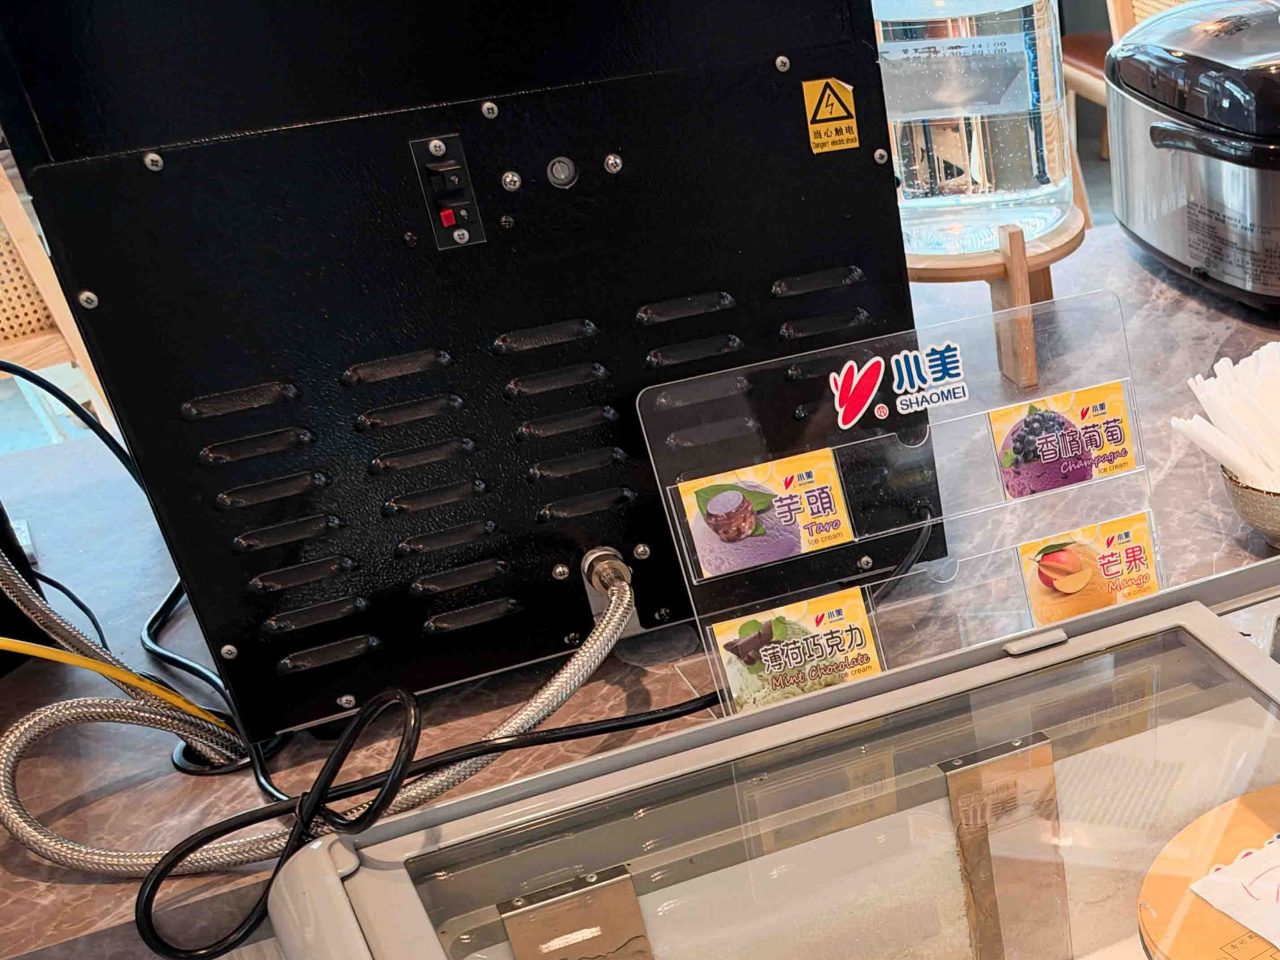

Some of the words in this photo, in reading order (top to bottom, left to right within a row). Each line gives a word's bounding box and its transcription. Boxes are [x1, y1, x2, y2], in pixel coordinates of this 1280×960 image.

[895, 344, 961, 390] 小美
[899, 385, 967, 412] SHAOMEI
[1036, 417, 1125, 463] 香檳葡萄
[1060, 448, 1129, 474] Champagne
[773, 485, 836, 525] 芋頭
[803, 519, 841, 537] Taro
[820, 531, 844, 543] cream
[1097, 544, 1147, 579] 芒果
[1107, 573, 1151, 594] Mango
[760, 623, 866, 674] 薄荷巧克力
[771, 671, 806, 691] Mint
[807, 652, 871, 681] Chocolate
